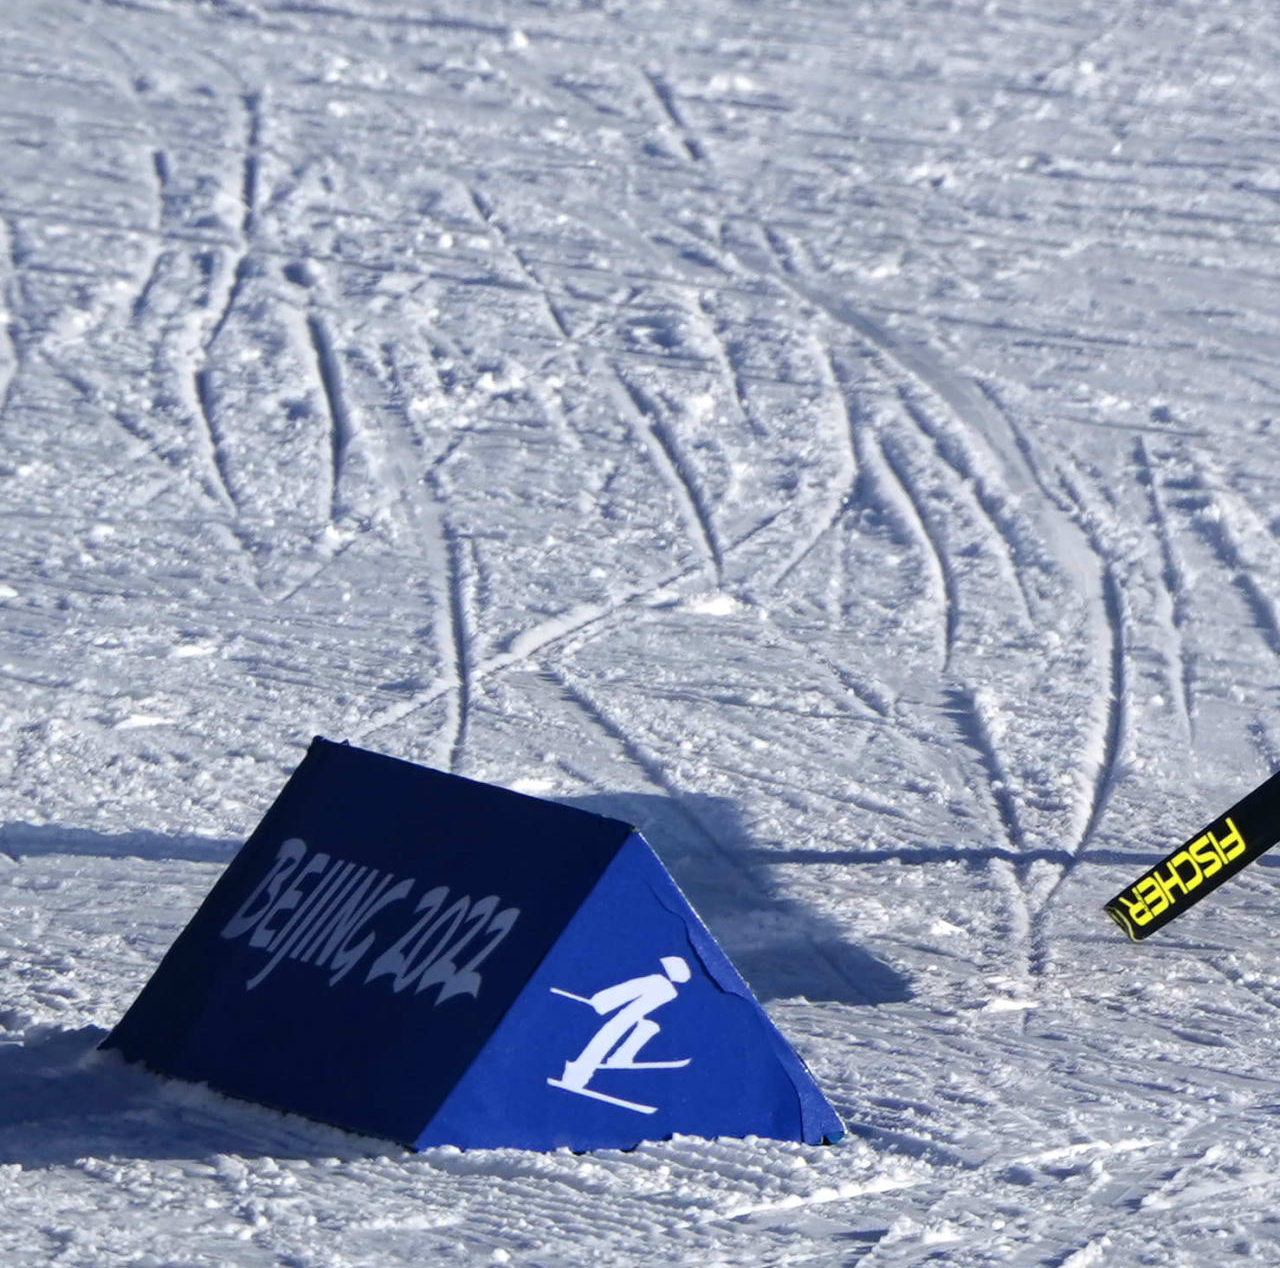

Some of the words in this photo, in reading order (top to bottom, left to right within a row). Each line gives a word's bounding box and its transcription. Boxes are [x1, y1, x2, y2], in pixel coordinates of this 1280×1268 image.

[220, 837, 417, 992] BEIJING
[363, 885, 522, 1007] 2022
[1118, 816, 1247, 927] FISCHER
